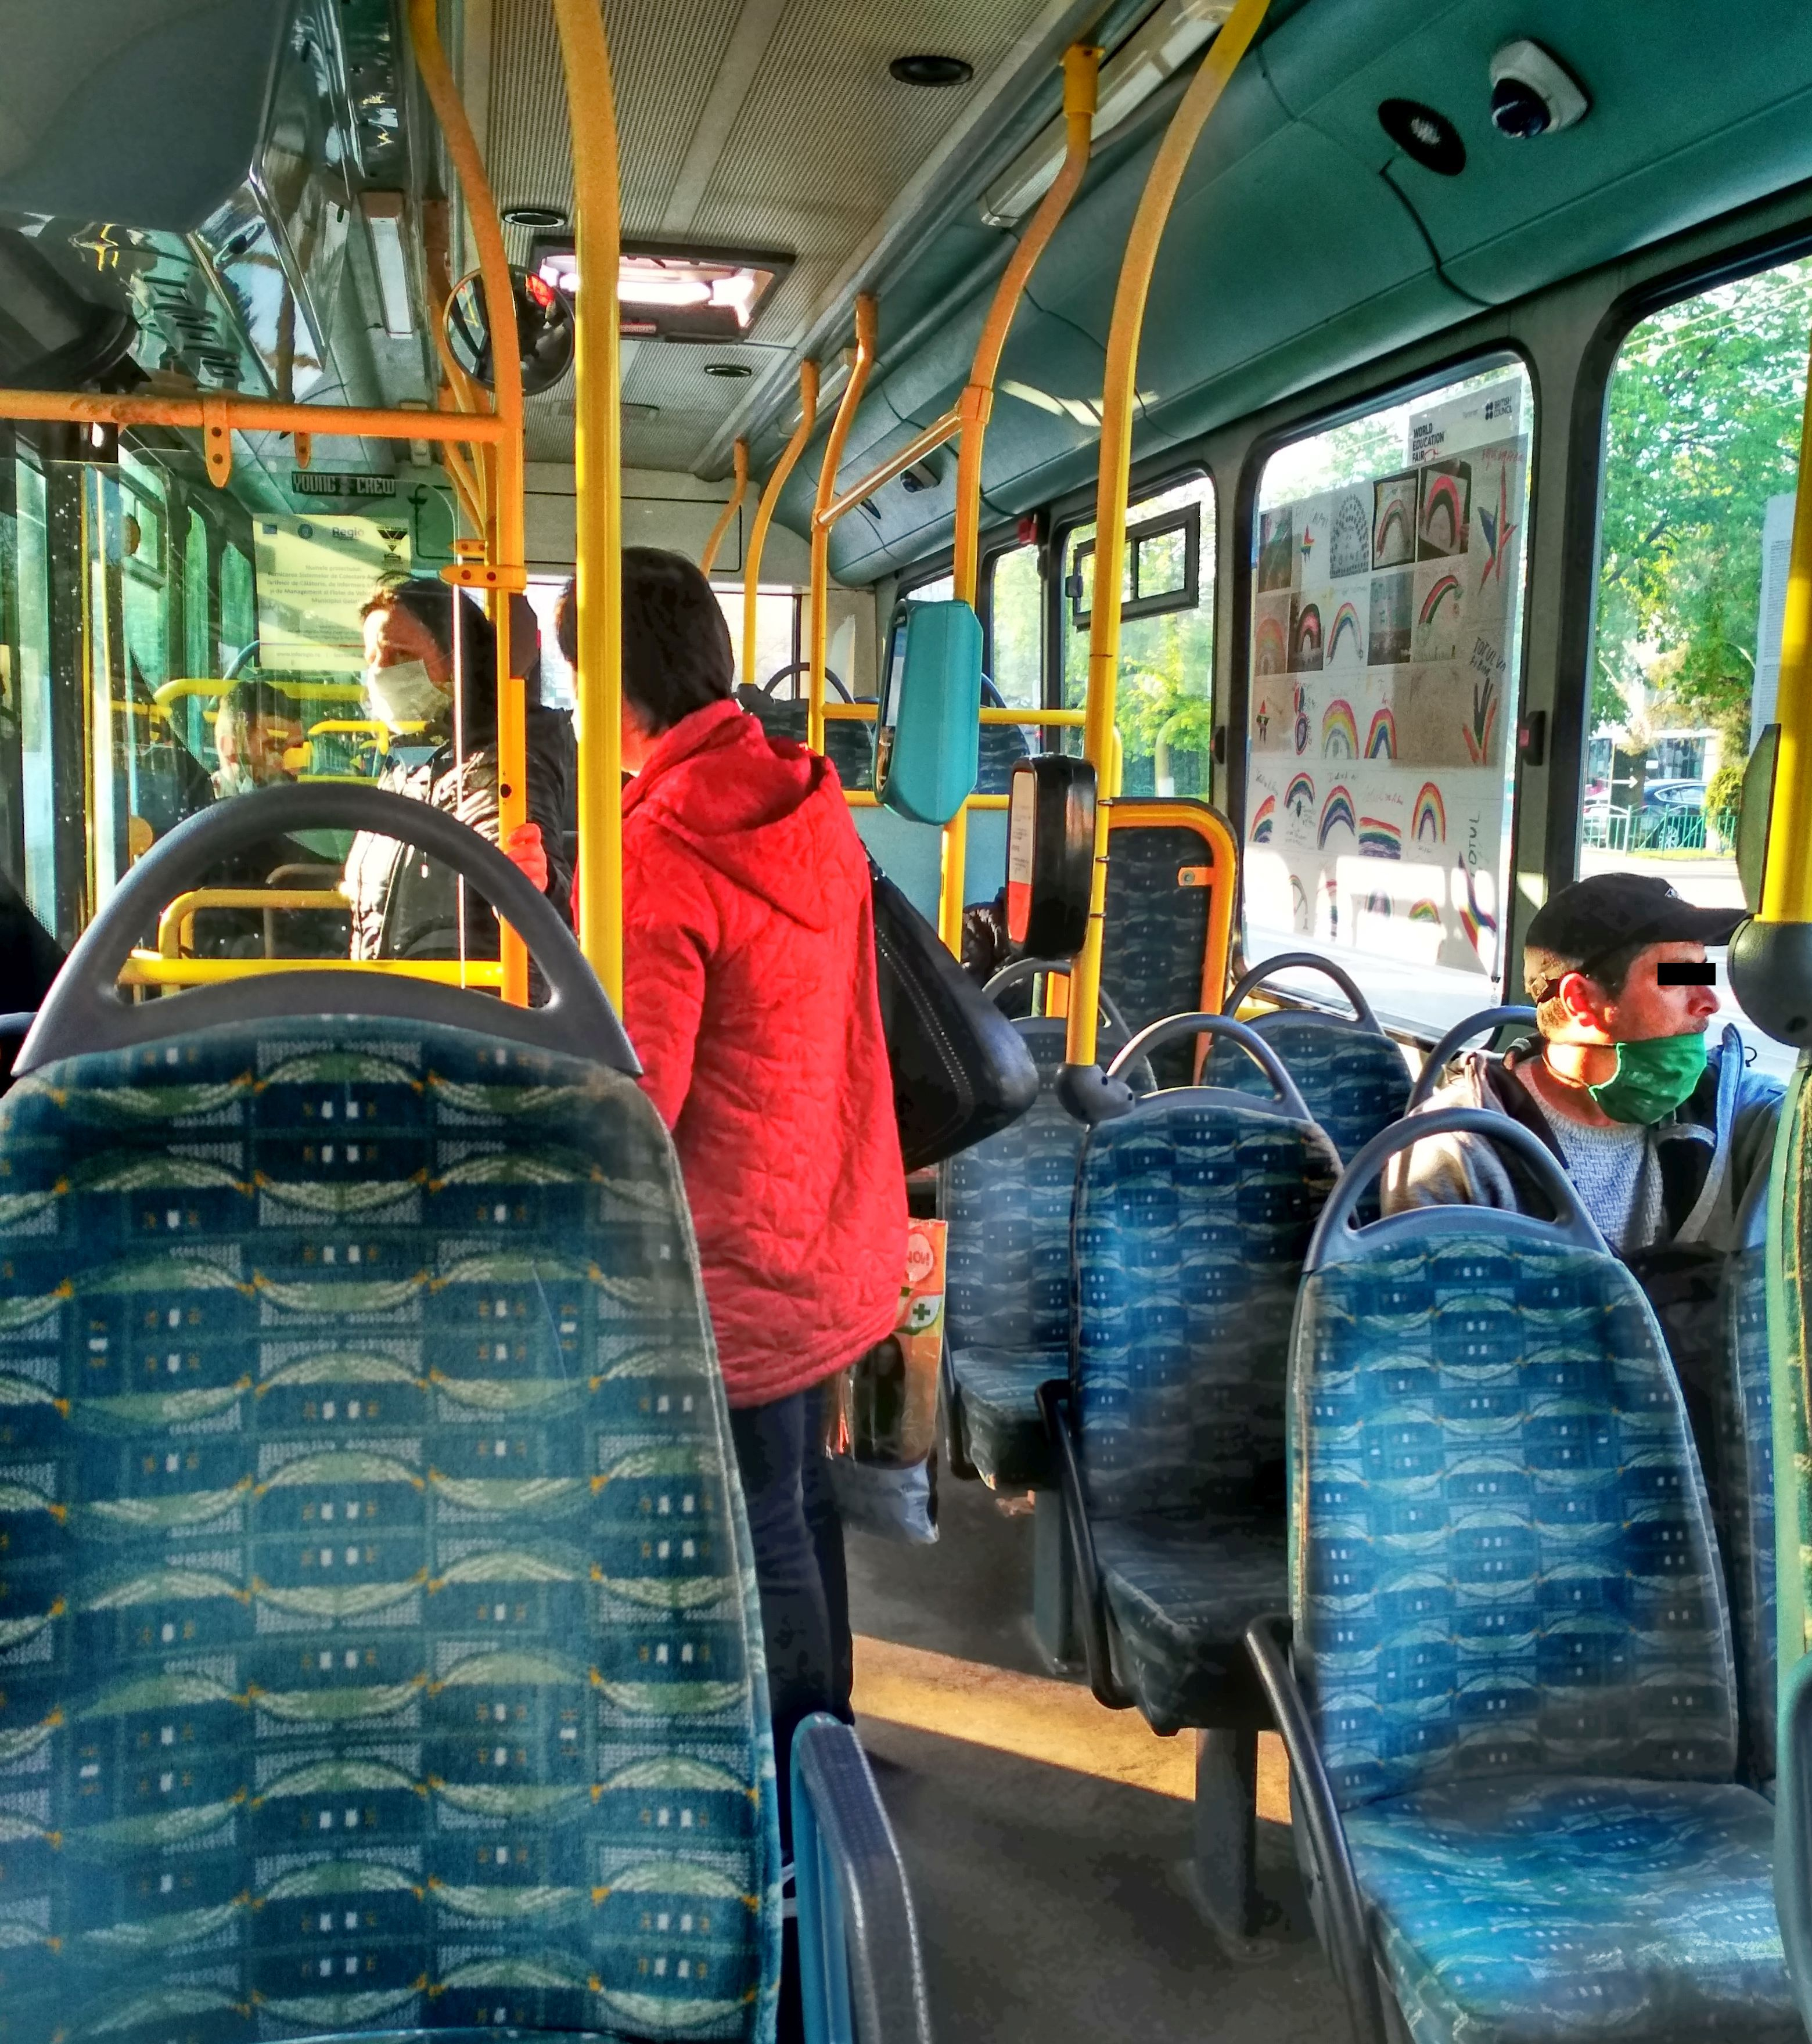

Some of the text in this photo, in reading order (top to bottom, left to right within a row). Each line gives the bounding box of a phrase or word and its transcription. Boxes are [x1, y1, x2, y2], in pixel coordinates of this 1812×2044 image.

[1494, 396, 1512, 409] BRITISH
[1493, 405, 1512, 418] COUNCIL
[1414, 423, 1433, 438] WORLD
[1412, 431, 1444, 451] EDUCATION
[1412, 450, 1425, 463] FAIR
[357, 477, 396, 495] CREW
[332, 527, 365, 539] Regio
